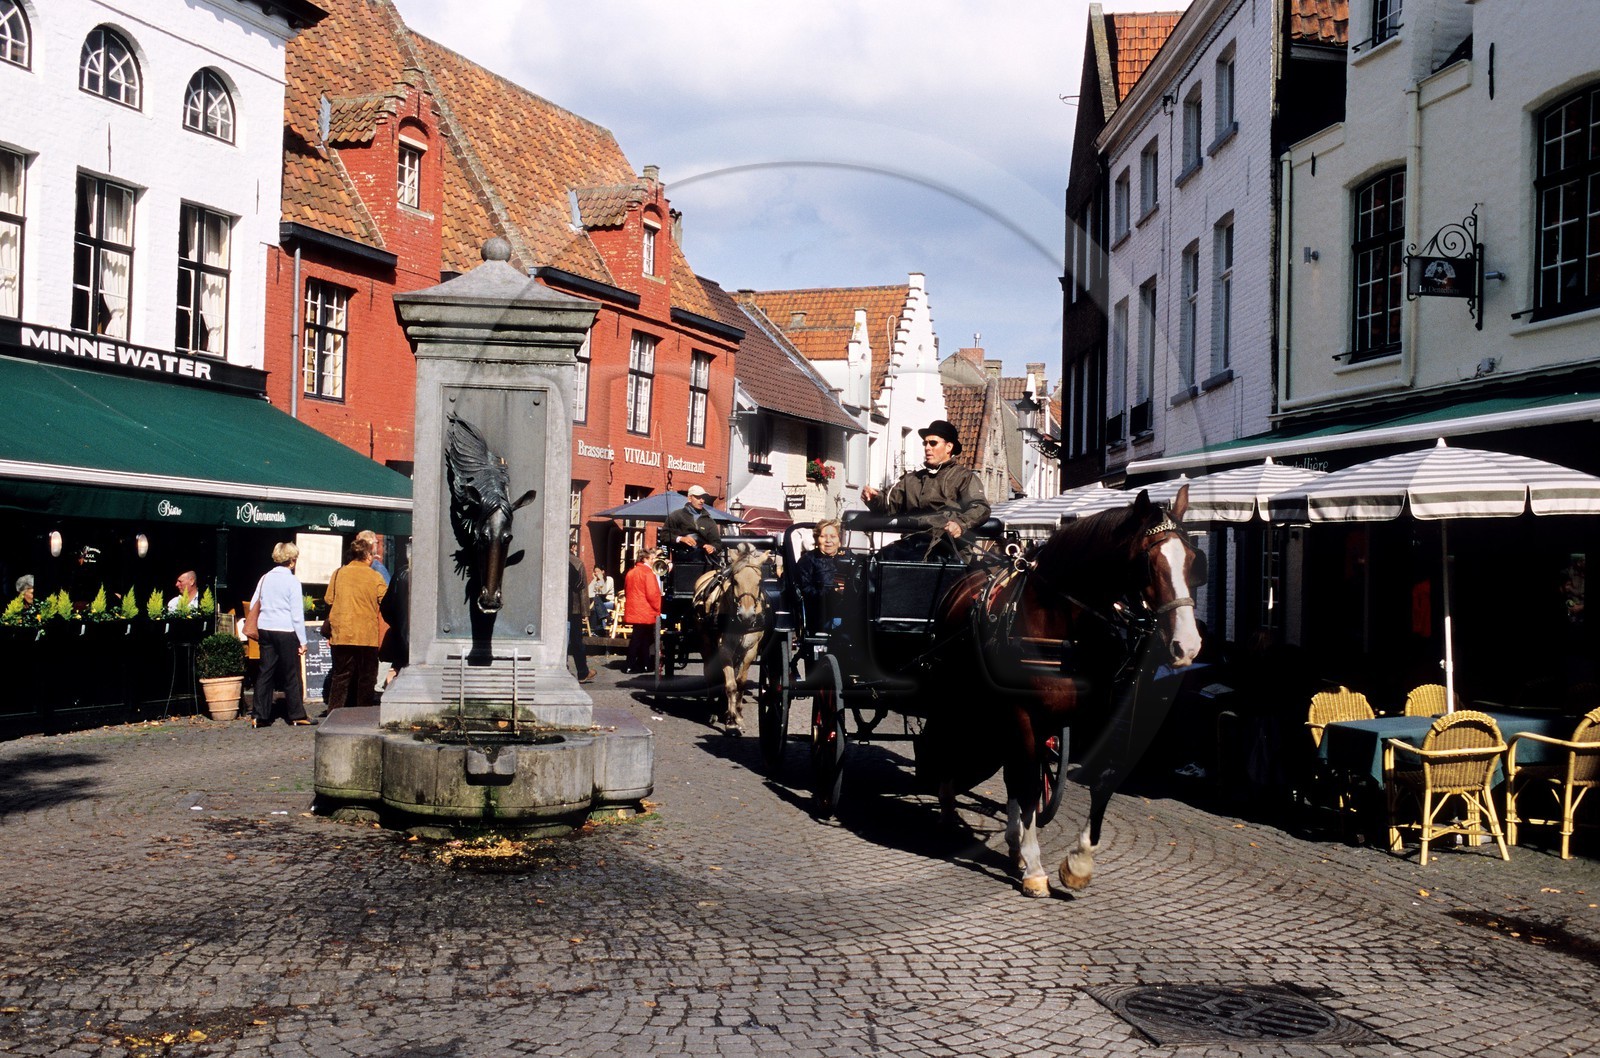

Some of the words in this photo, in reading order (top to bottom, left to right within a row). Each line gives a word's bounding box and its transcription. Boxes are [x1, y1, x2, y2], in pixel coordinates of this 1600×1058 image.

[21, 326, 212, 381] MINNEWATER
[577, 439, 615, 461] Brasserie
[623, 446, 662, 468] VIVALDI
[667, 454, 706, 474] Restaurant
[157, 499, 183, 517] Bistro
[241, 502, 287, 524] Minnewater
